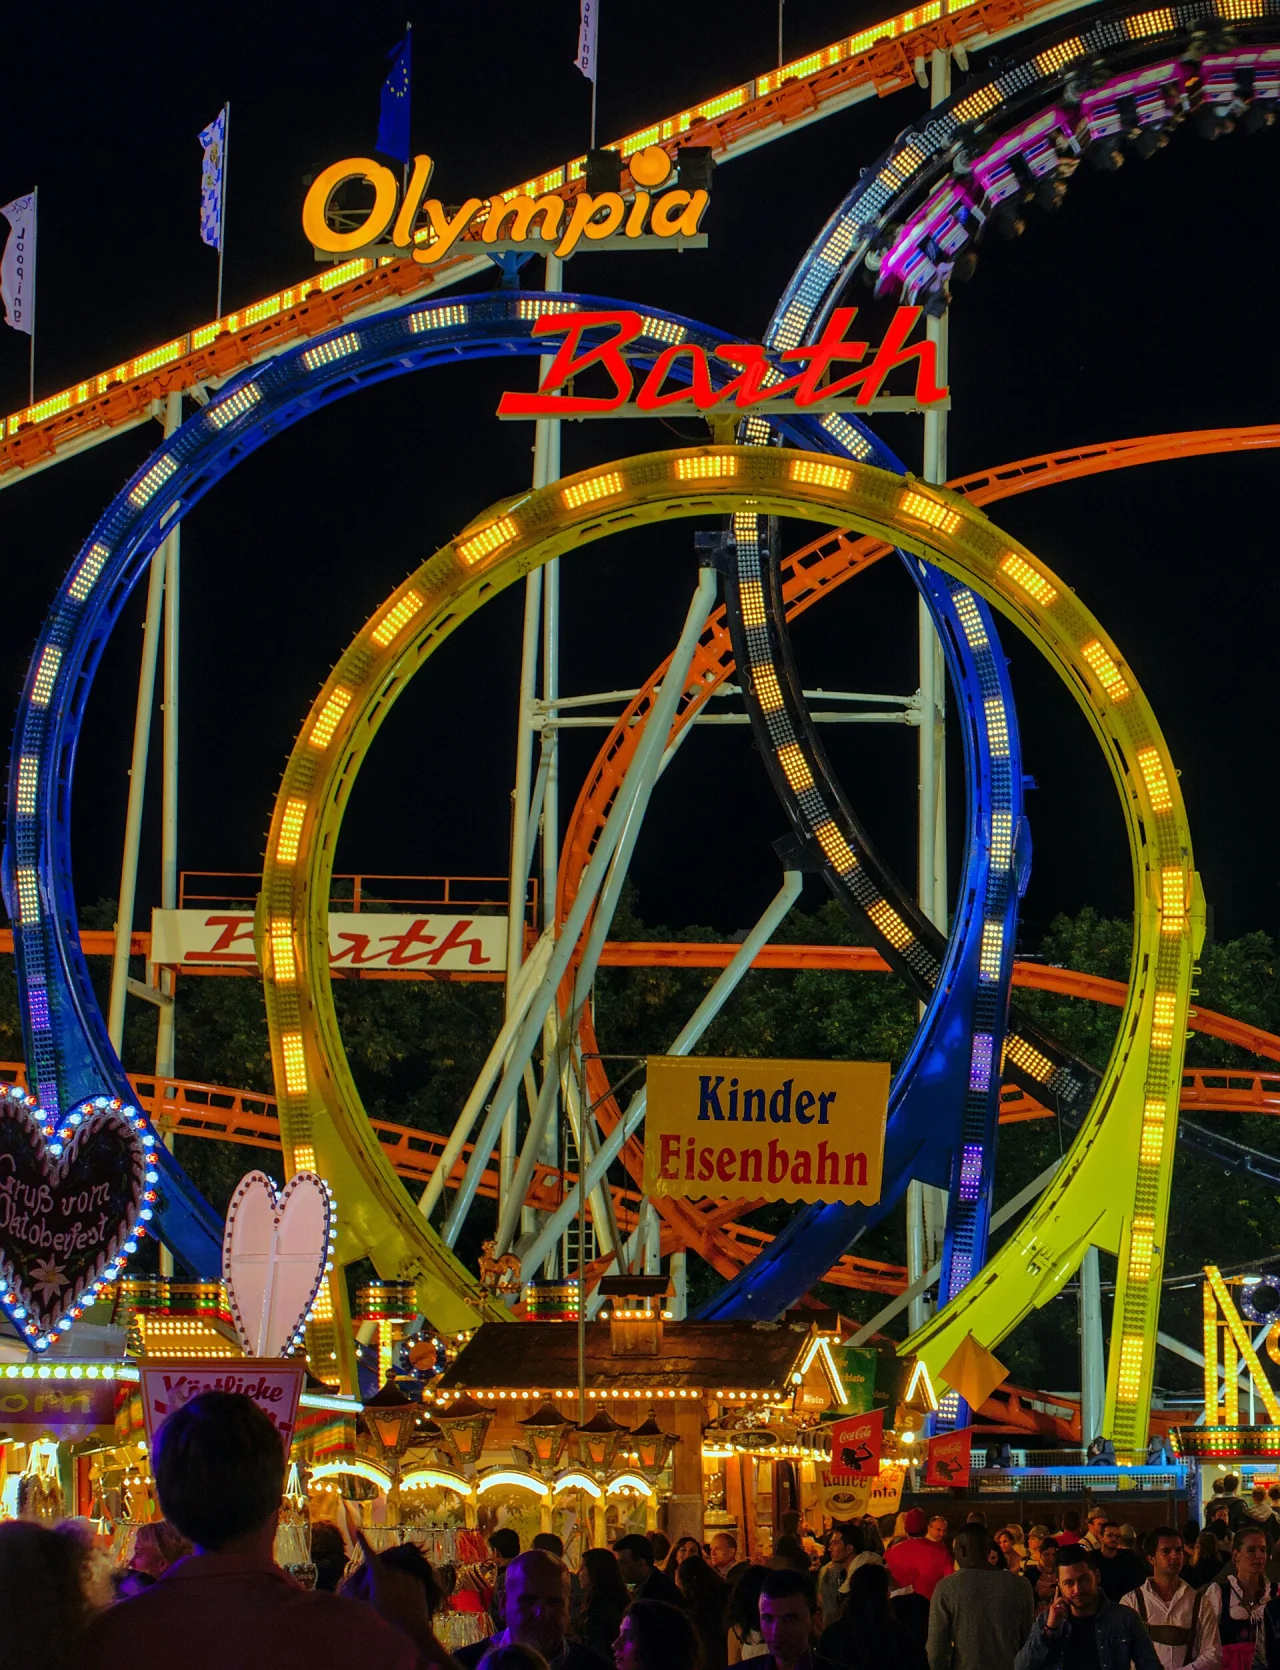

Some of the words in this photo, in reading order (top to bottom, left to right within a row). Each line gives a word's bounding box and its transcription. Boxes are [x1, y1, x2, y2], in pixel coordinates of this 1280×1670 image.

[302, 145, 711, 264] Olympia
[495, 305, 950, 416] Barth
[184, 916, 491, 966] Brth
[697, 1075, 837, 1125] Kinder
[0, 1153, 54, 1217] Gruß
[61, 1181, 111, 1217] vom
[658, 1134, 868, 1186] Eisenbahn
[0, 1191, 109, 1260] Oktoberfest
